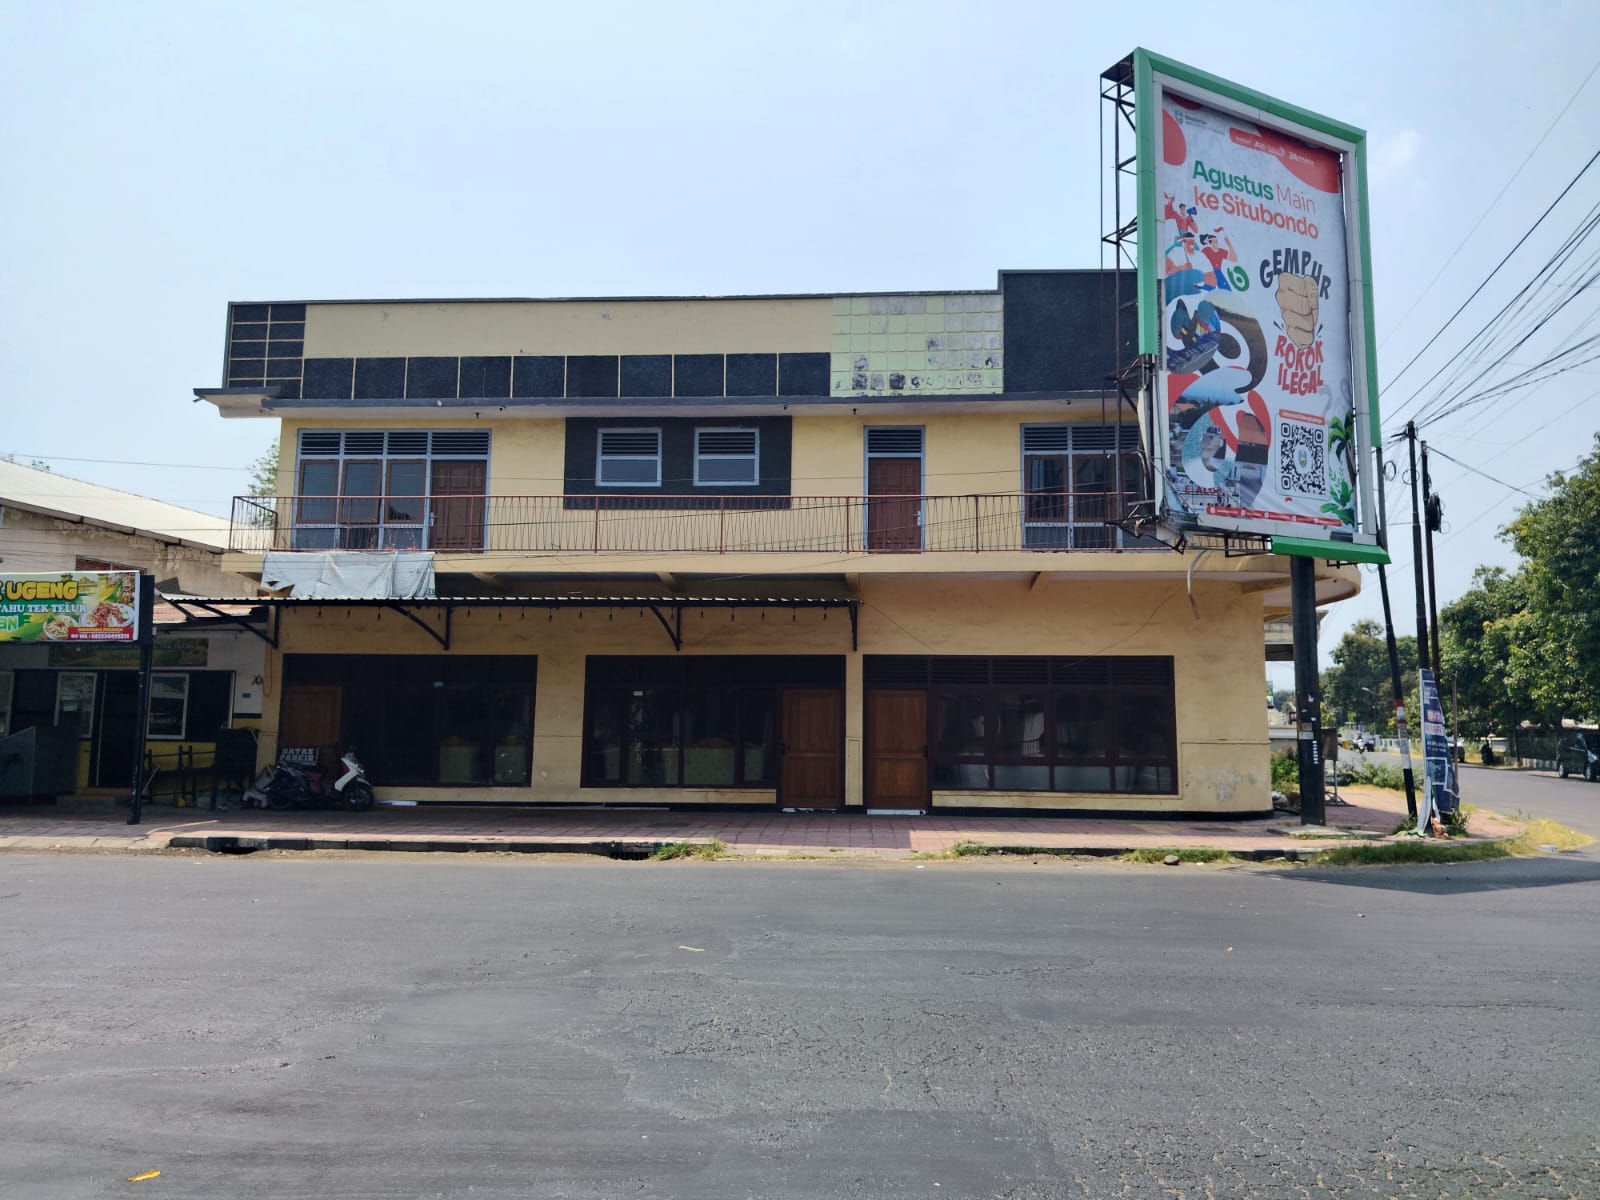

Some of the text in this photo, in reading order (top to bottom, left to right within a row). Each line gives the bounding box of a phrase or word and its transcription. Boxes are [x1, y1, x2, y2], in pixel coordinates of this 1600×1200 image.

[1192, 160, 1316, 215] Agustus Main
[1193, 185, 1319, 239] ke Situbondo
[1260, 247, 1332, 300] GEMPUR
[1274, 335, 1324, 372] ROKOK
[1277, 363, 1324, 396] ILEGAL
[6, 581, 79, 600] UGENG
[27, 604, 48, 613] TEK
[51, 604, 87, 613] TELUR
